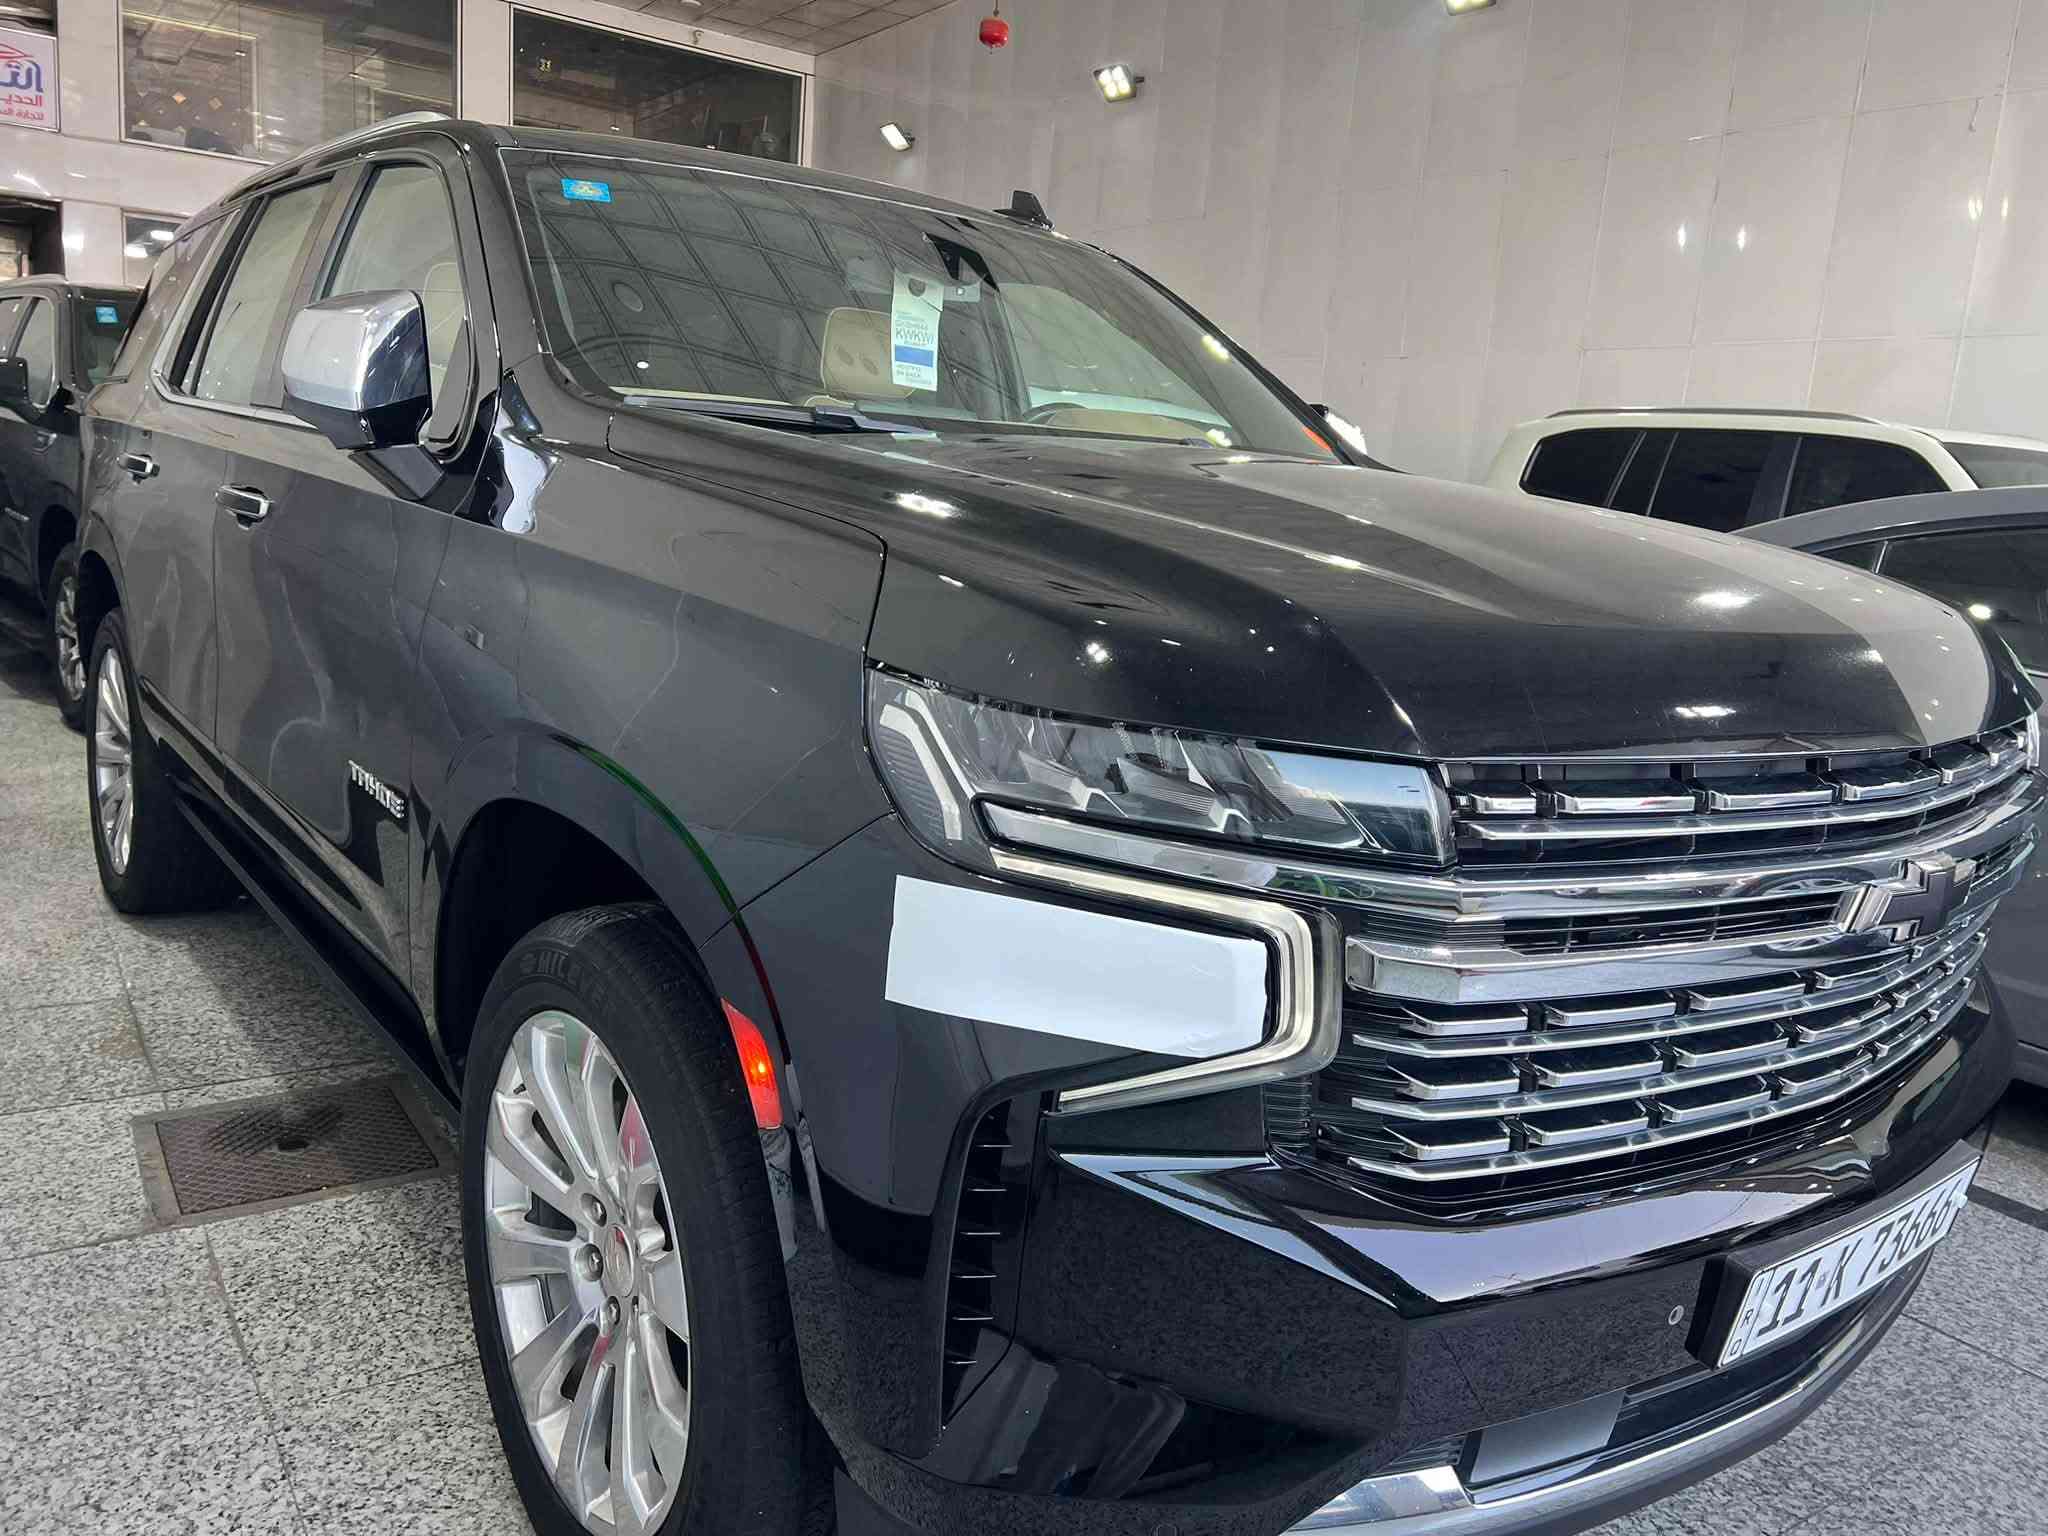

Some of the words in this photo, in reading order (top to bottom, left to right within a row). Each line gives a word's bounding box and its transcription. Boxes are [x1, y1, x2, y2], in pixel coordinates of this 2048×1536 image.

[348, 759, 405, 818] TAHOE
[1757, 1257, 1822, 1338] 11
[1821, 1239, 1862, 1307] K
[1858, 1177, 1962, 1286] 73666
